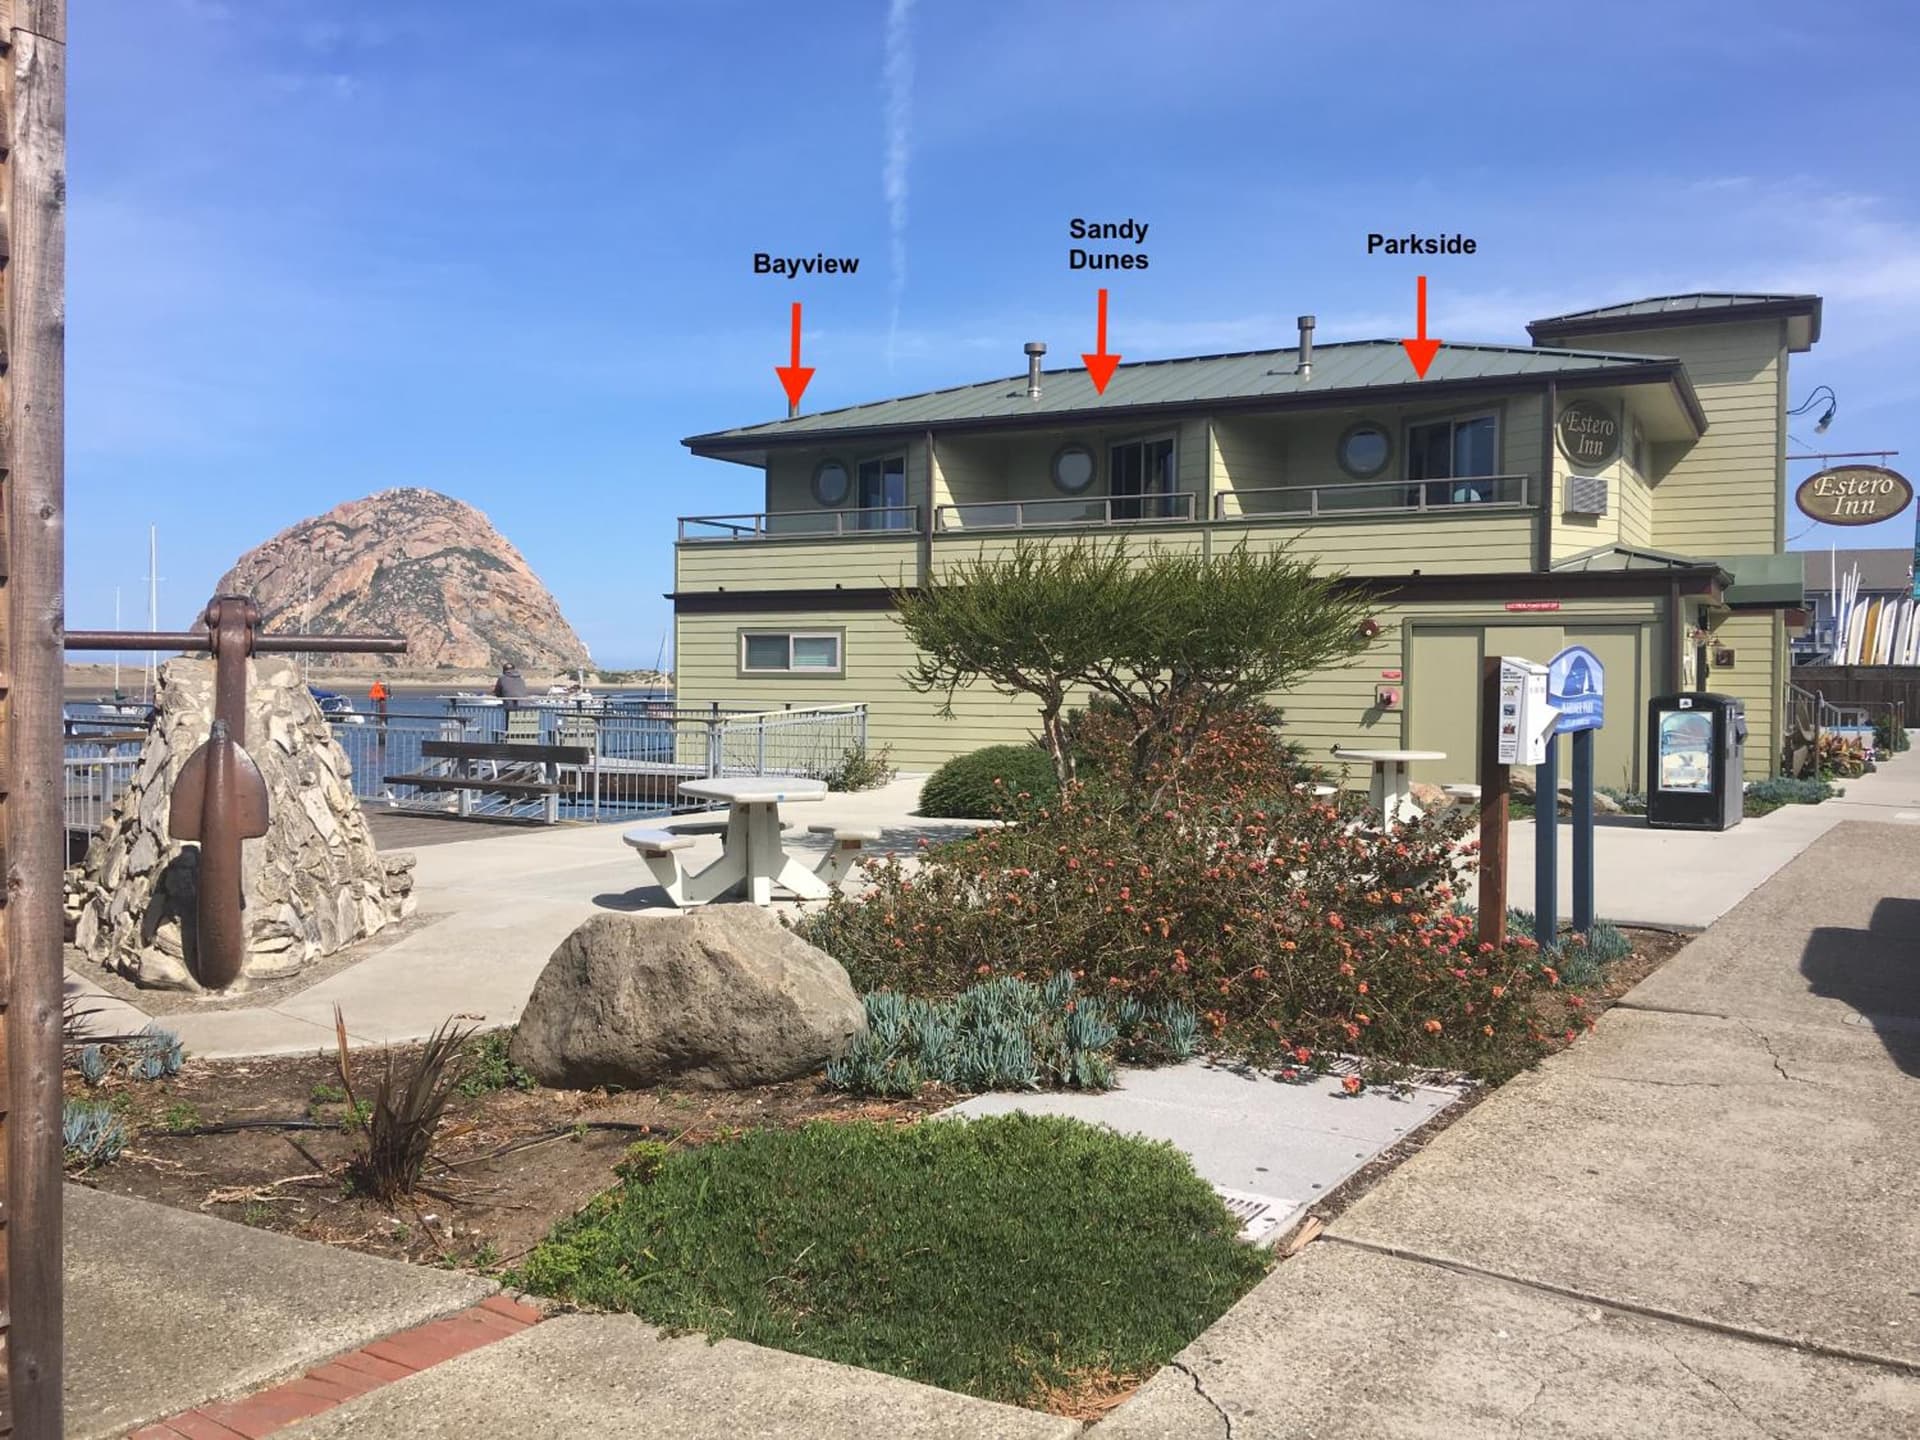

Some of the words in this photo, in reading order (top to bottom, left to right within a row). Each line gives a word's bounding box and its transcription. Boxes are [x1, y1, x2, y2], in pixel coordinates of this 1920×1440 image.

[1566, 411, 1614, 436] Estero
[1576, 434, 1604, 456] Inn
[1814, 476, 1894, 496] Estero
[1831, 496, 1876, 515] Inn
